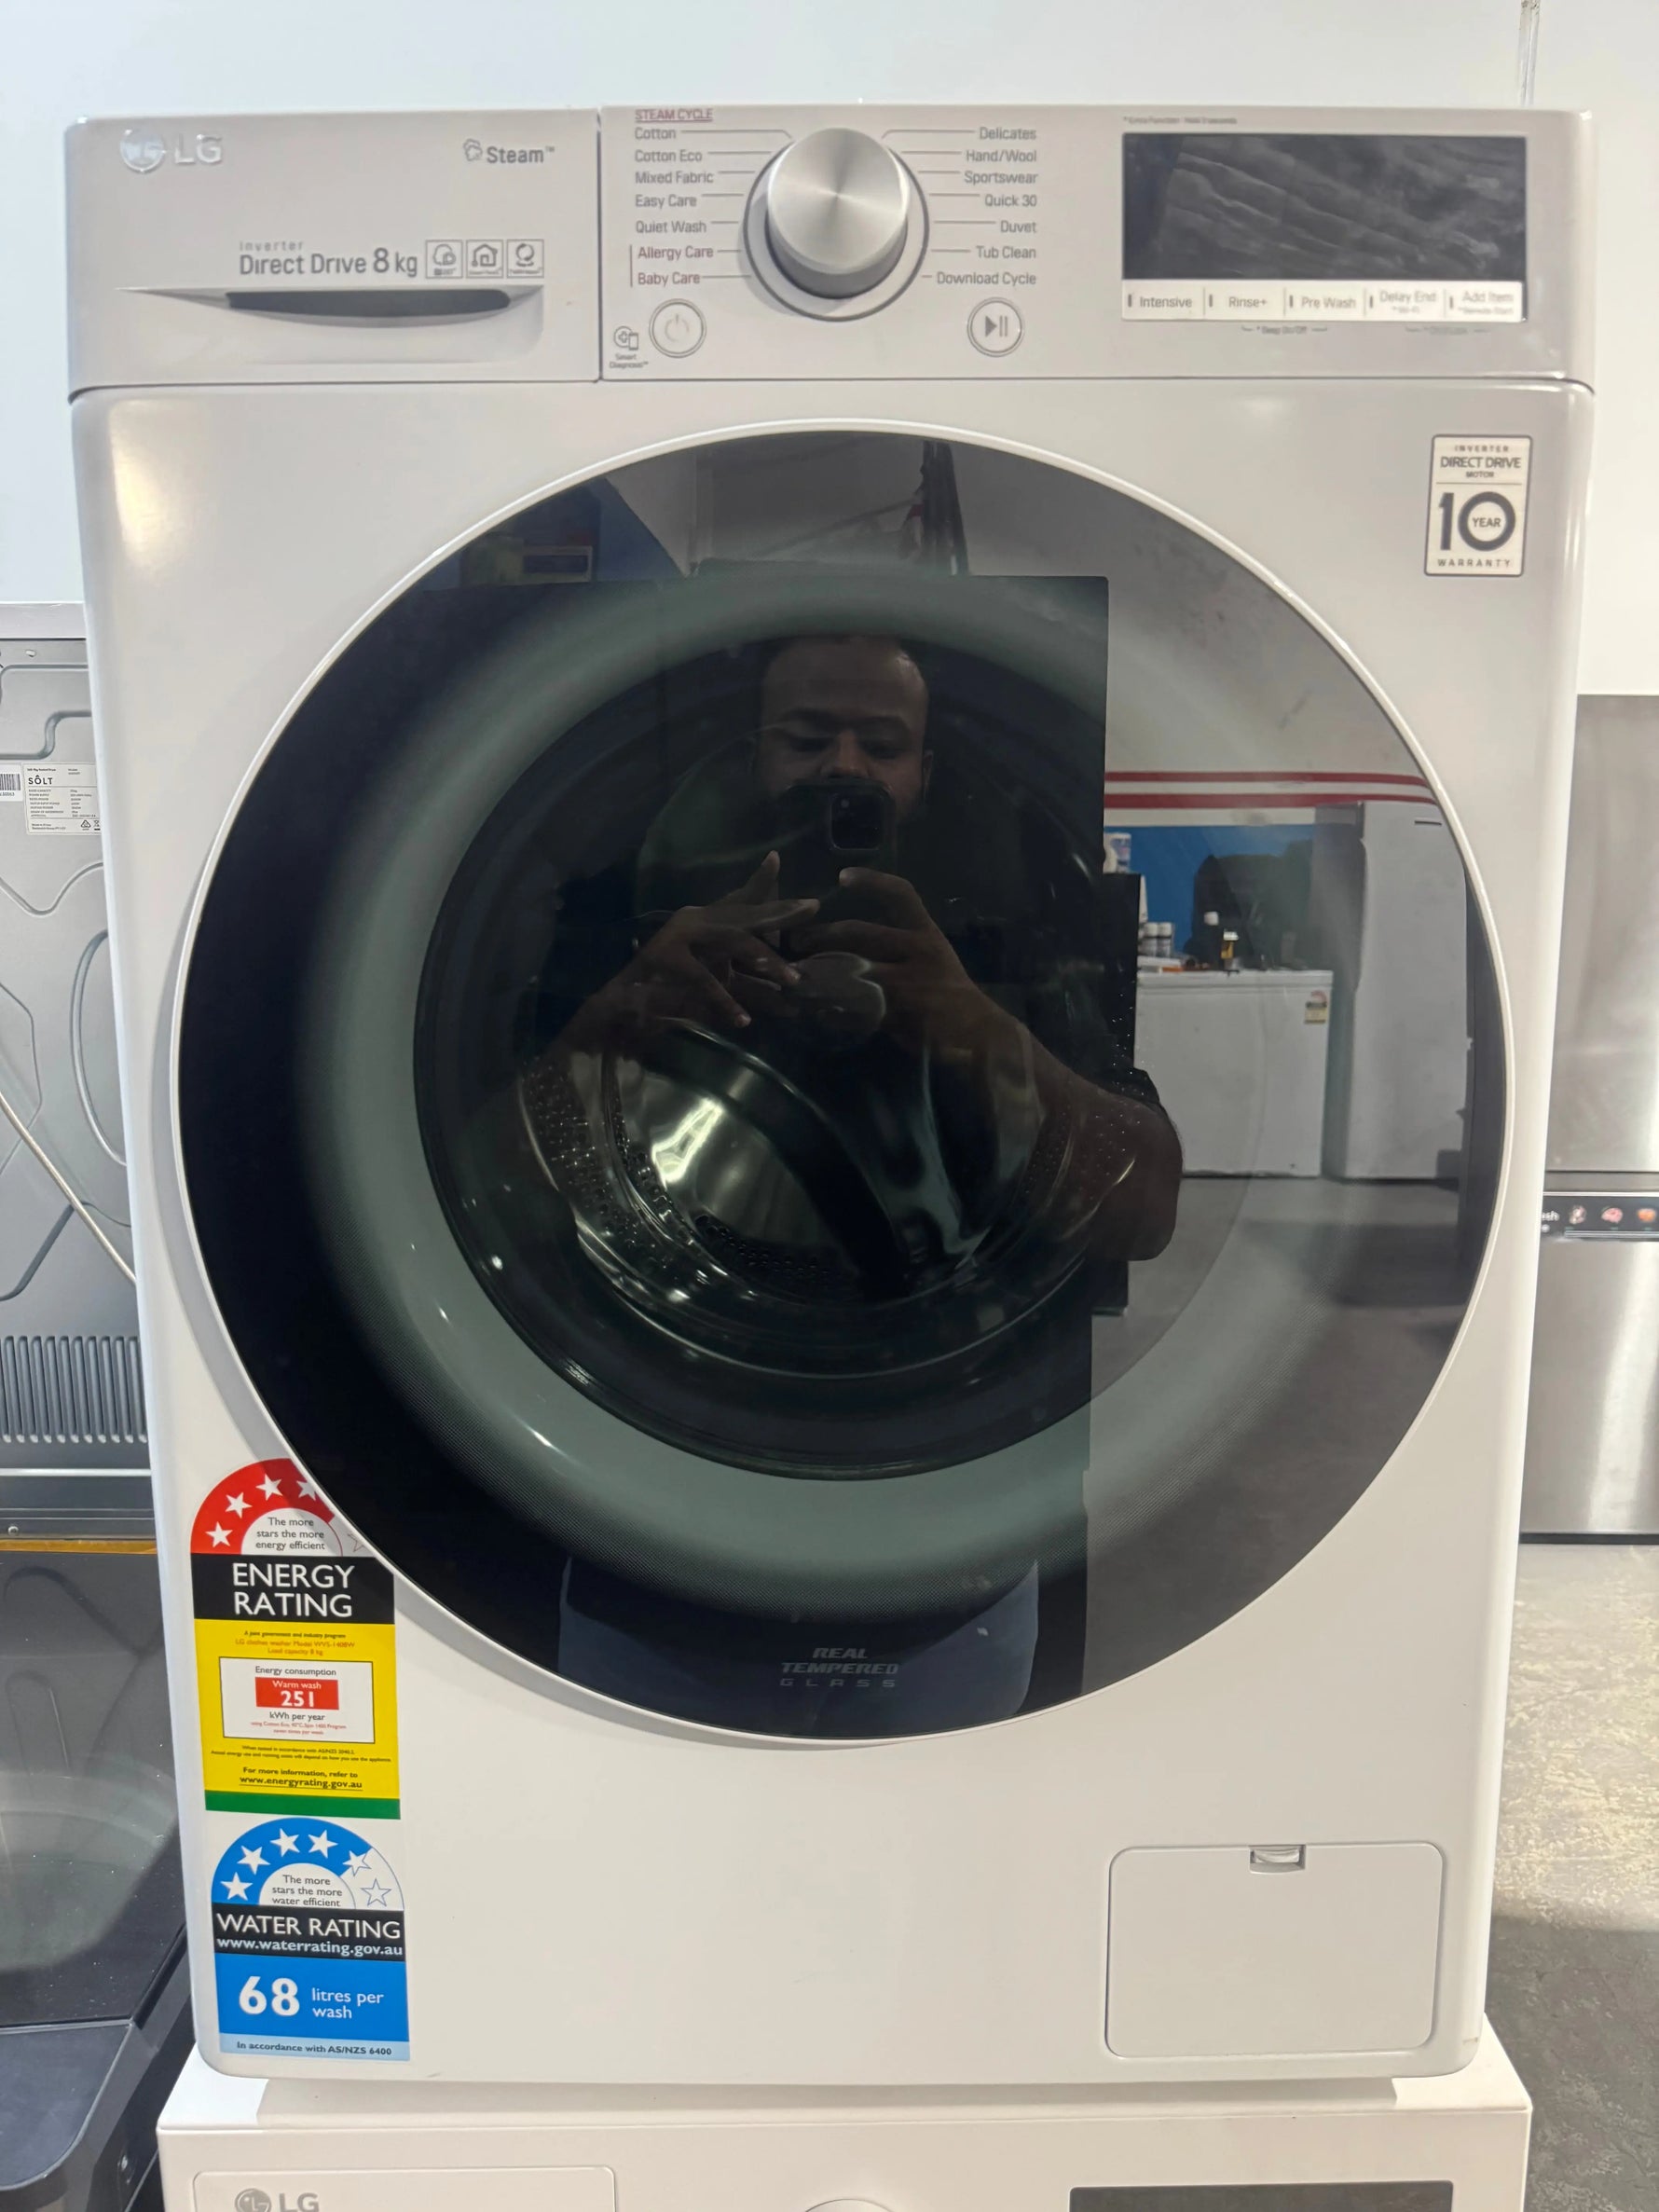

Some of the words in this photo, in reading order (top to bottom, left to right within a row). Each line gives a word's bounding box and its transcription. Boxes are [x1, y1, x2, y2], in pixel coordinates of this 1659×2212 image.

[635, 109, 675, 120] STEAM
[678, 108, 713, 119] CYCLE
[635, 127, 677, 141] Cotton
[979, 127, 1037, 140] Delicates
[174, 134, 224, 164] LG
[635, 149, 677, 163] Cotton
[679, 149, 703, 162] Eco
[966, 150, 1037, 163] Hand/Wool
[635, 172, 673, 185] Mixed
[676, 172, 715, 184] Fabric
[964, 171, 1038, 185] Sportswear
[635, 194, 665, 210] Easy
[668, 194, 698, 208] Care
[984, 194, 1019, 207] Quick
[1021, 194, 1037, 207] 30
[636, 220, 668, 234] Quiet
[671, 220, 707, 233] Wash
[1000, 220, 1037, 233] Duvet
[638, 246, 682, 262] Allergy
[685, 246, 714, 259] Care
[976, 245, 999, 259] Tub
[1002, 245, 1036, 259] Clean
[240, 254, 305, 275] Direct
[310, 253, 367, 274] Drive
[373, 247, 391, 274] 8
[394, 251, 418, 279] kg
[638, 272, 668, 288] Baby
[672, 271, 700, 285] Care
[937, 271, 999, 285] Download
[1002, 271, 1036, 287] Cycle
[1139, 295, 1193, 309] Intensive
[1228, 295, 1268, 309] Rinse+
[1301, 295, 1321, 309] Pre
[1323, 295, 1357, 309] Wash
[1379, 289, 1411, 304] Delay
[1415, 290, 1436, 302] End
[1462, 290, 1486, 303] Add
[1489, 290, 1514, 303] Item
[1440, 457, 1483, 468] DIRECT
[1486, 457, 1521, 469] DRIVE
[1439, 491, 1516, 552] 10
[1473, 517, 1501, 528] YEAR
[267, 1517, 286, 1526] The
[281, 1530, 295, 1538] the
[298, 1531, 324, 1539] more
[255, 1542, 286, 1551] energy
[289, 1541, 325, 1550] efficient
[232, 1562, 355, 1588] ENERGY
[234, 1591, 352, 1617] RATING
[812, 1647, 869, 1660] REAL
[255, 1666, 282, 1676] Energy
[285, 1668, 336, 1676] consumption
[781, 1662, 899, 1675] TEMPERED
[273, 1680, 298, 1688] Warm
[779, 1678, 897, 1688] GLASS
[281, 1690, 314, 1707] 251
[269, 1711, 290, 1720] kWh
[292, 1713, 306, 1723] per
[308, 1714, 325, 1723] year
[281, 1768, 327, 1778] information,
[240, 1777, 363, 1789] www.energyrating.gov.au
[282, 1875, 302, 1885] The
[304, 1877, 331, 1886] more
[272, 1887, 295, 1895] stars
[297, 1888, 314, 1896] the
[303, 1898, 341, 1907] efficient
[216, 1913, 302, 1936] WATER
[308, 1917, 401, 1939] RATING
[216, 1939, 404, 1957] www.waterrating.gov.au
[239, 1975, 300, 2016] 68
[311, 1987, 351, 2003] litres
[357, 1991, 384, 2007] per
[312, 2005, 352, 2019] wash
[237, 2041, 247, 2050] In
[248, 2043, 304, 2053] accordance
[327, 2045, 367, 2055] AS/NZS
[369, 2047, 392, 2056] 6400
[279, 2192, 320, 2212] LG
